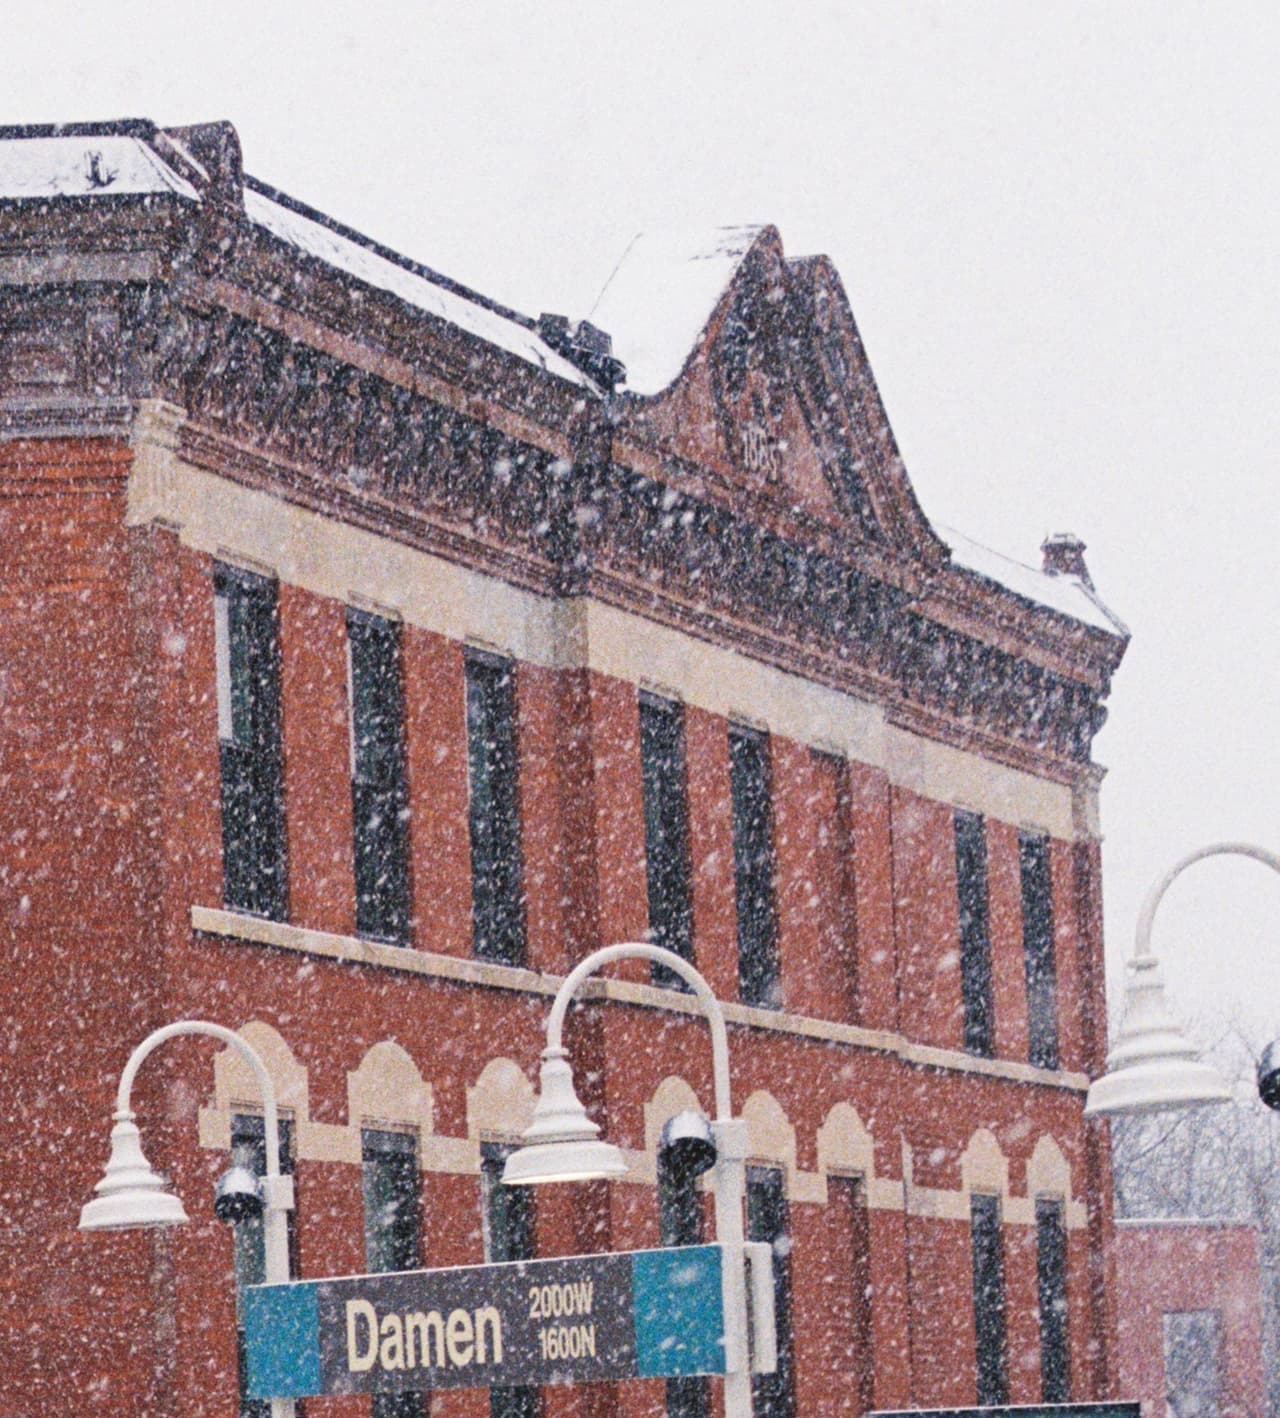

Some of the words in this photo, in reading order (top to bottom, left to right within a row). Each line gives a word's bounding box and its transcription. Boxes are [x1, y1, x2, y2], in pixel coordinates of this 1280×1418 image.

[529, 1282, 593, 1318] 2000W
[346, 1299, 502, 1372] Damen
[539, 1324, 596, 1361] 1600N
